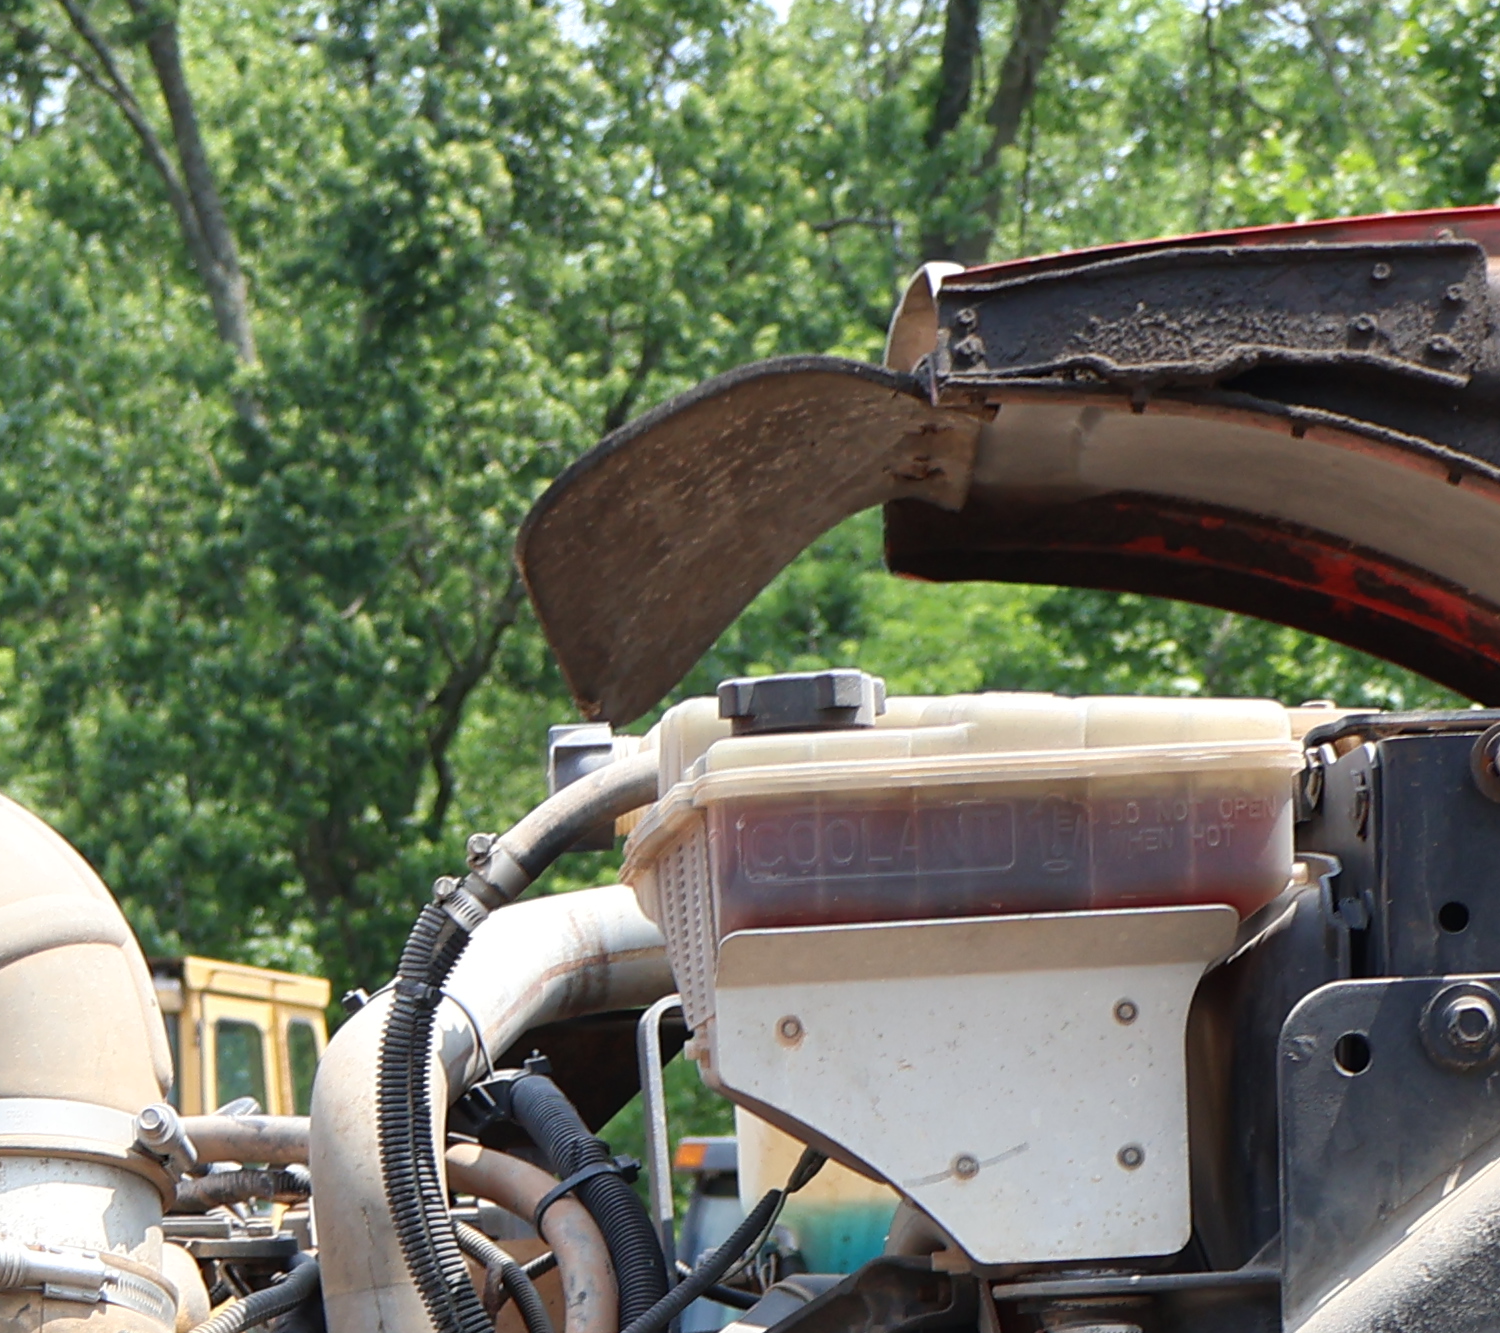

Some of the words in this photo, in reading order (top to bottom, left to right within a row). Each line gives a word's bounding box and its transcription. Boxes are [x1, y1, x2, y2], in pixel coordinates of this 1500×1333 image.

[1109, 801, 1141, 826] DO
[1157, 797, 1204, 823] NOT
[1218, 795, 1278, 821] OPEN
[750, 808, 1003, 869] COOLANT
[1192, 822, 1236, 848] HOT
